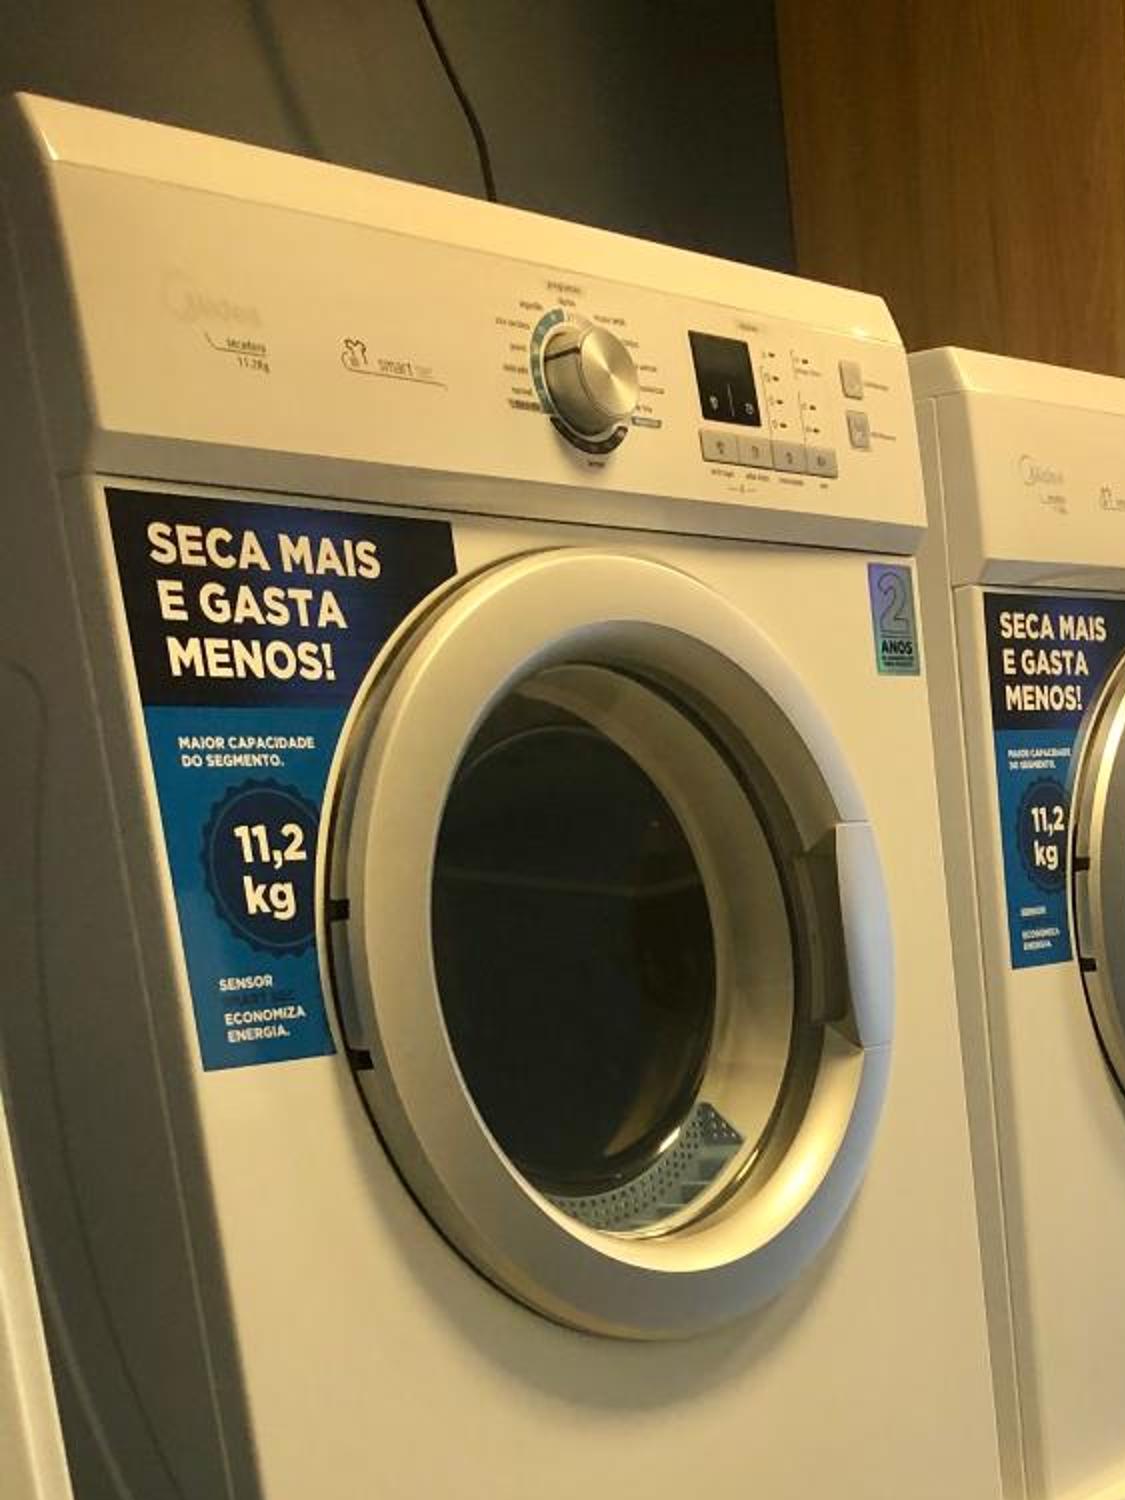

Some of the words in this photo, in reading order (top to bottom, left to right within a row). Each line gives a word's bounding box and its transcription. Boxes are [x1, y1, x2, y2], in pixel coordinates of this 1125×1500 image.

[147, 521, 272, 572] SECA
[277, 532, 382, 580] MAIS
[156, 579, 190, 622] E
[199, 581, 349, 629] GASTA
[1000, 611, 1055, 641] SECA
[1058, 614, 1107, 642] MAIS
[166, 636, 337, 682] MENOS!
[881, 639, 913, 656] ANOS
[1003, 649, 1017, 675] E
[1021, 649, 1089, 676] GASTA
[1005, 684, 1083, 712] MENOS!
[177, 735, 226, 750] MAIOR
[227, 735, 316, 750] CAPACIDADE
[181, 754, 203, 768] DO
[206, 753, 286, 768] SEGMENTO.
[1031, 805, 1065, 837] 11,2
[233, 823, 308, 871] 11,2
[1033, 839, 1060, 871] kg
[242, 875, 297, 921] kg
[218, 974, 274, 992] SENSOR
[223, 1005, 307, 1027] ECONOMIZA
[227, 1024, 291, 1044] ENERGIA.
